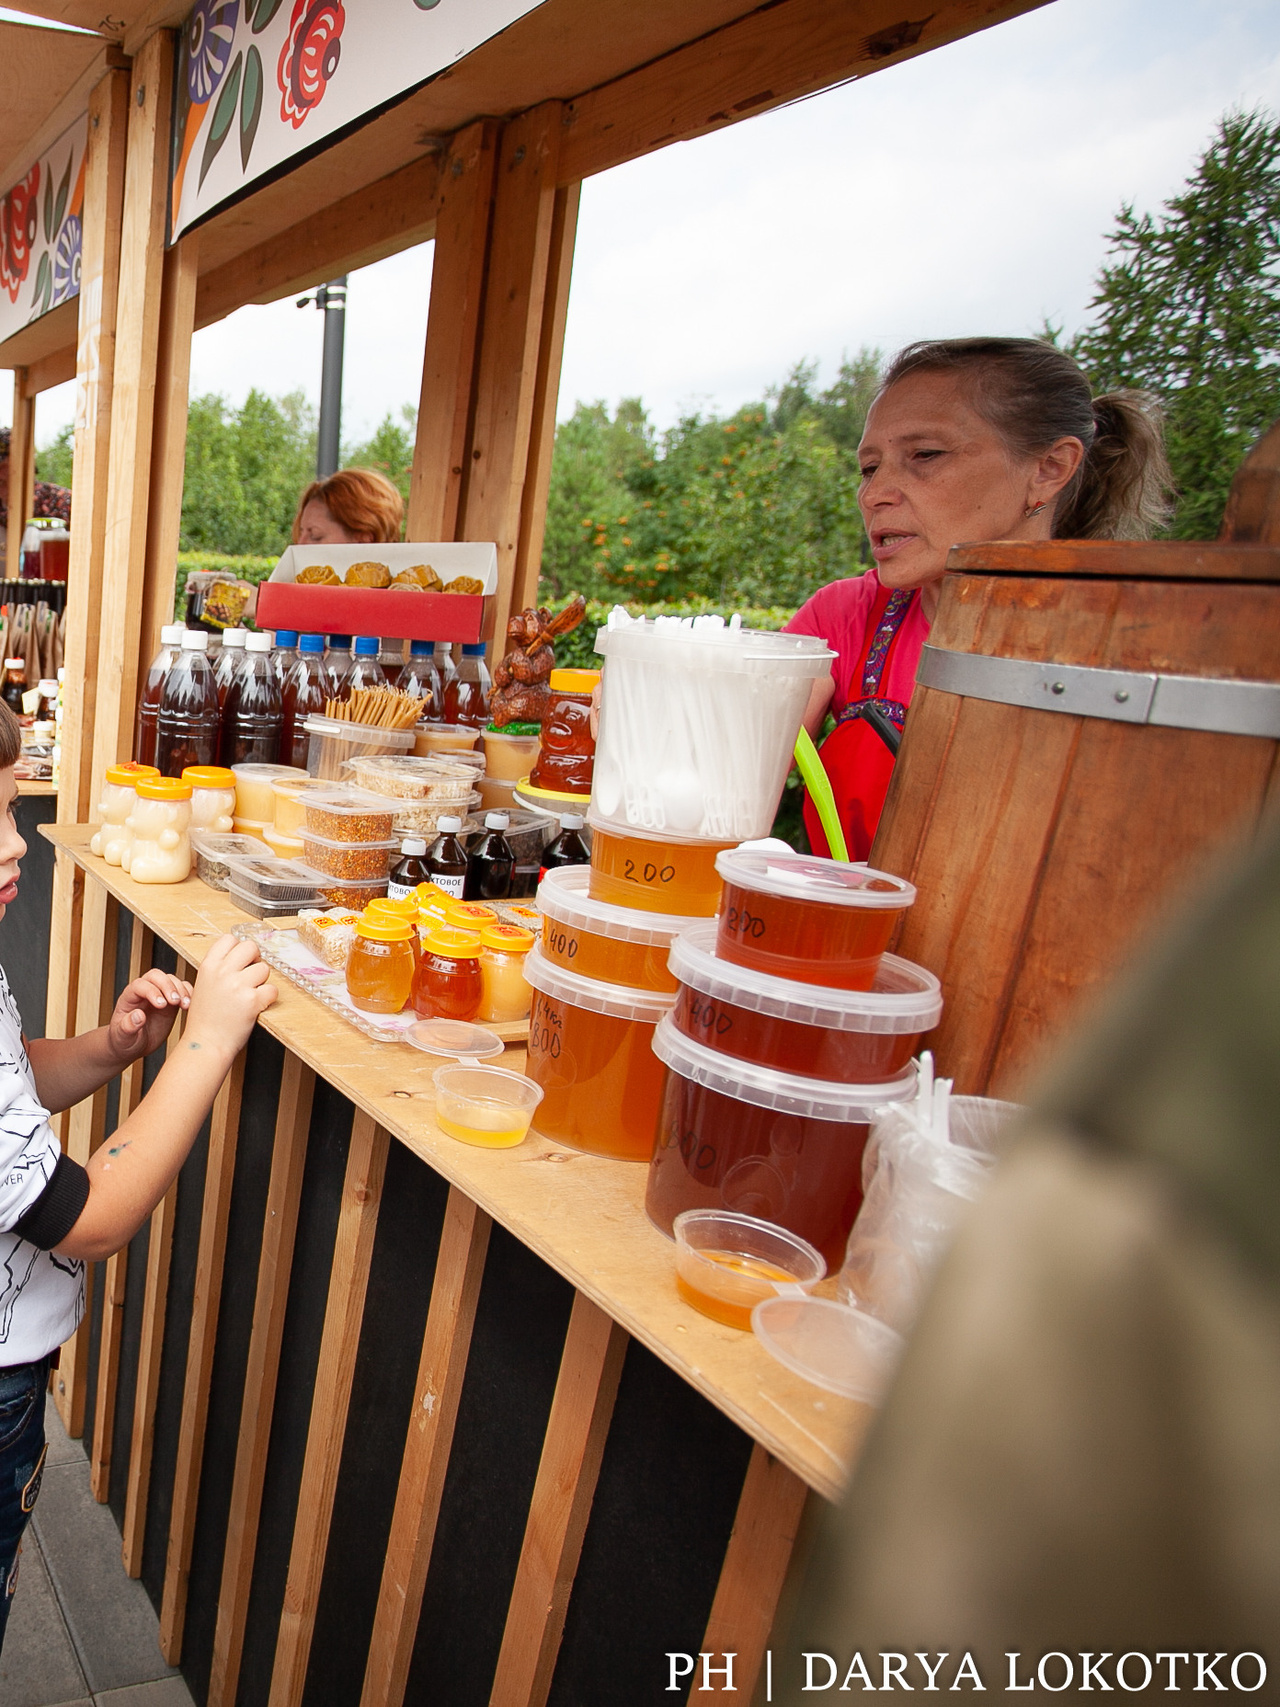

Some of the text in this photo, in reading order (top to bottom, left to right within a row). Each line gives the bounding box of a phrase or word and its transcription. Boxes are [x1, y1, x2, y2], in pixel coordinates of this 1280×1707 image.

[625, 859, 676, 883] 200
[727, 906, 767, 938] 200
[549, 928, 579, 958] 400
[690, 999, 734, 1035] 400
[531, 1022, 561, 1059] 800
[668, 1120, 718, 1170] 800
